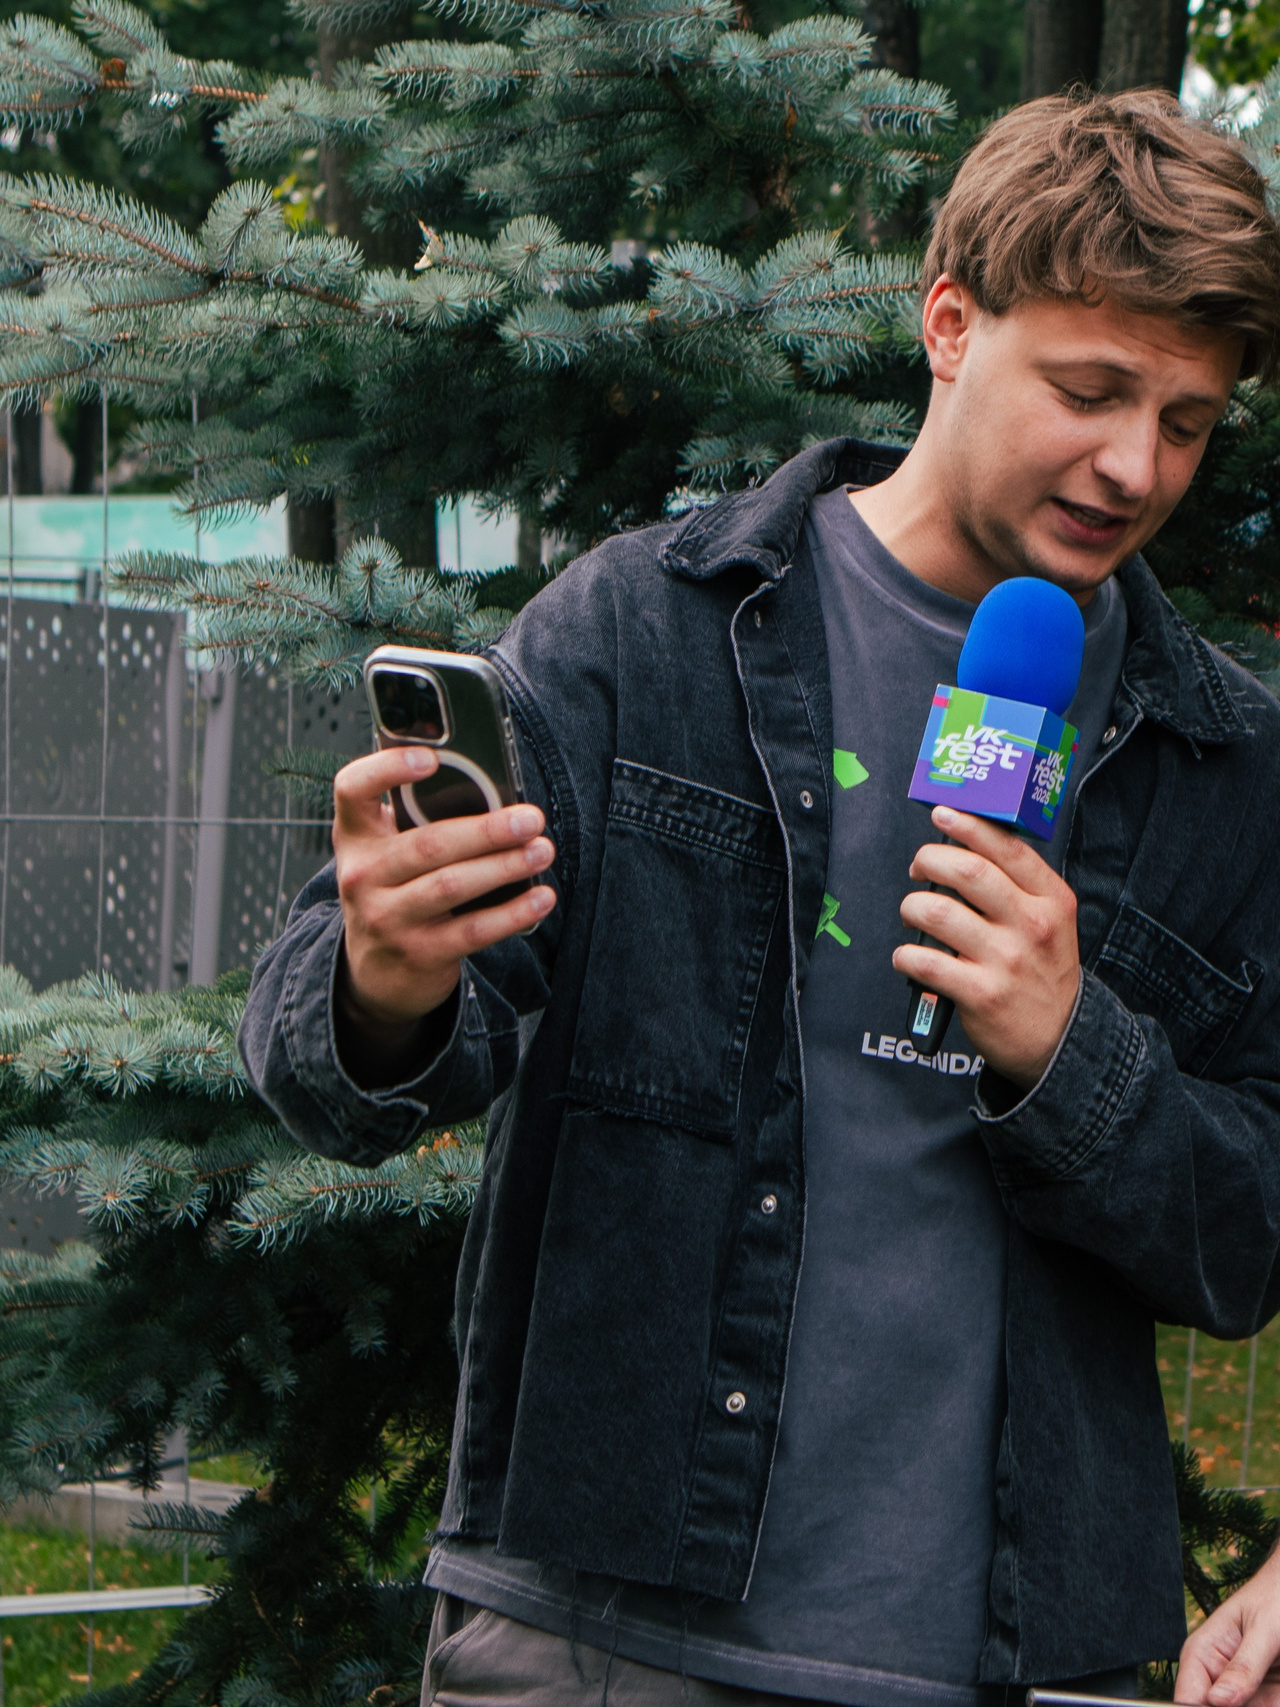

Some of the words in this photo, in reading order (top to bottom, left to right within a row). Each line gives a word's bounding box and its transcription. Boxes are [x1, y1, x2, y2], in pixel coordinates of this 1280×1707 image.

[963, 725, 1009, 746] VK
[934, 733, 1023, 771] fest
[1046, 750, 1065, 771] VK
[938, 760, 991, 781] 2025
[1032, 758, 1066, 795] fest
[1031, 787, 1052, 806] 2025
